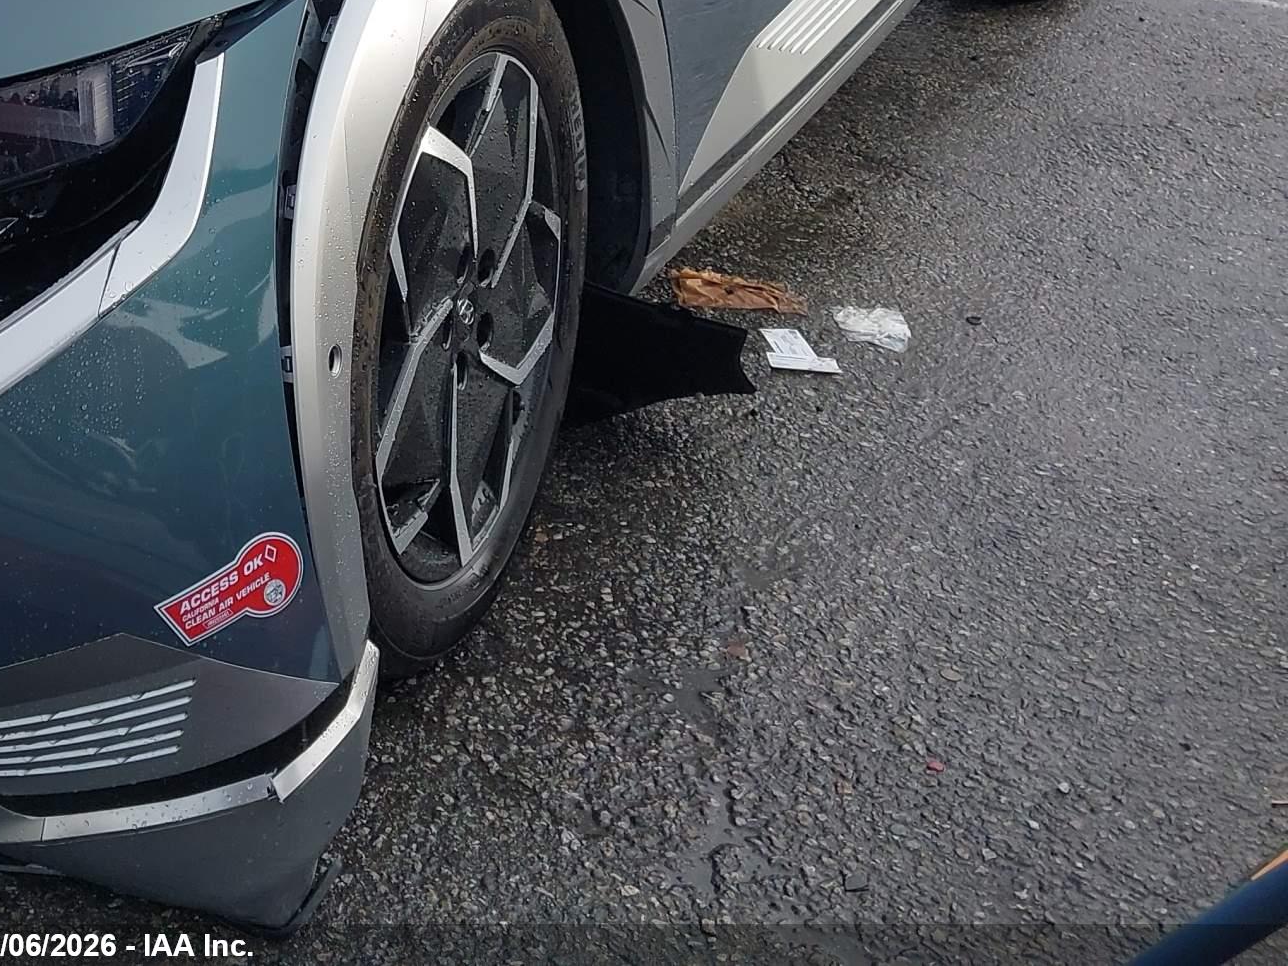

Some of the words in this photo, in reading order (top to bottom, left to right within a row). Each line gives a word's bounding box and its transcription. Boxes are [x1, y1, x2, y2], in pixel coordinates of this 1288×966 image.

[180, 571, 239, 614] ACCESS
[244, 553, 263, 575] OK
[182, 597, 219, 622] CALIFORNIA
[185, 607, 216, 629] CLEAN
[219, 596, 233, 612] AIR
[236, 572, 271, 601] VEHICLE
